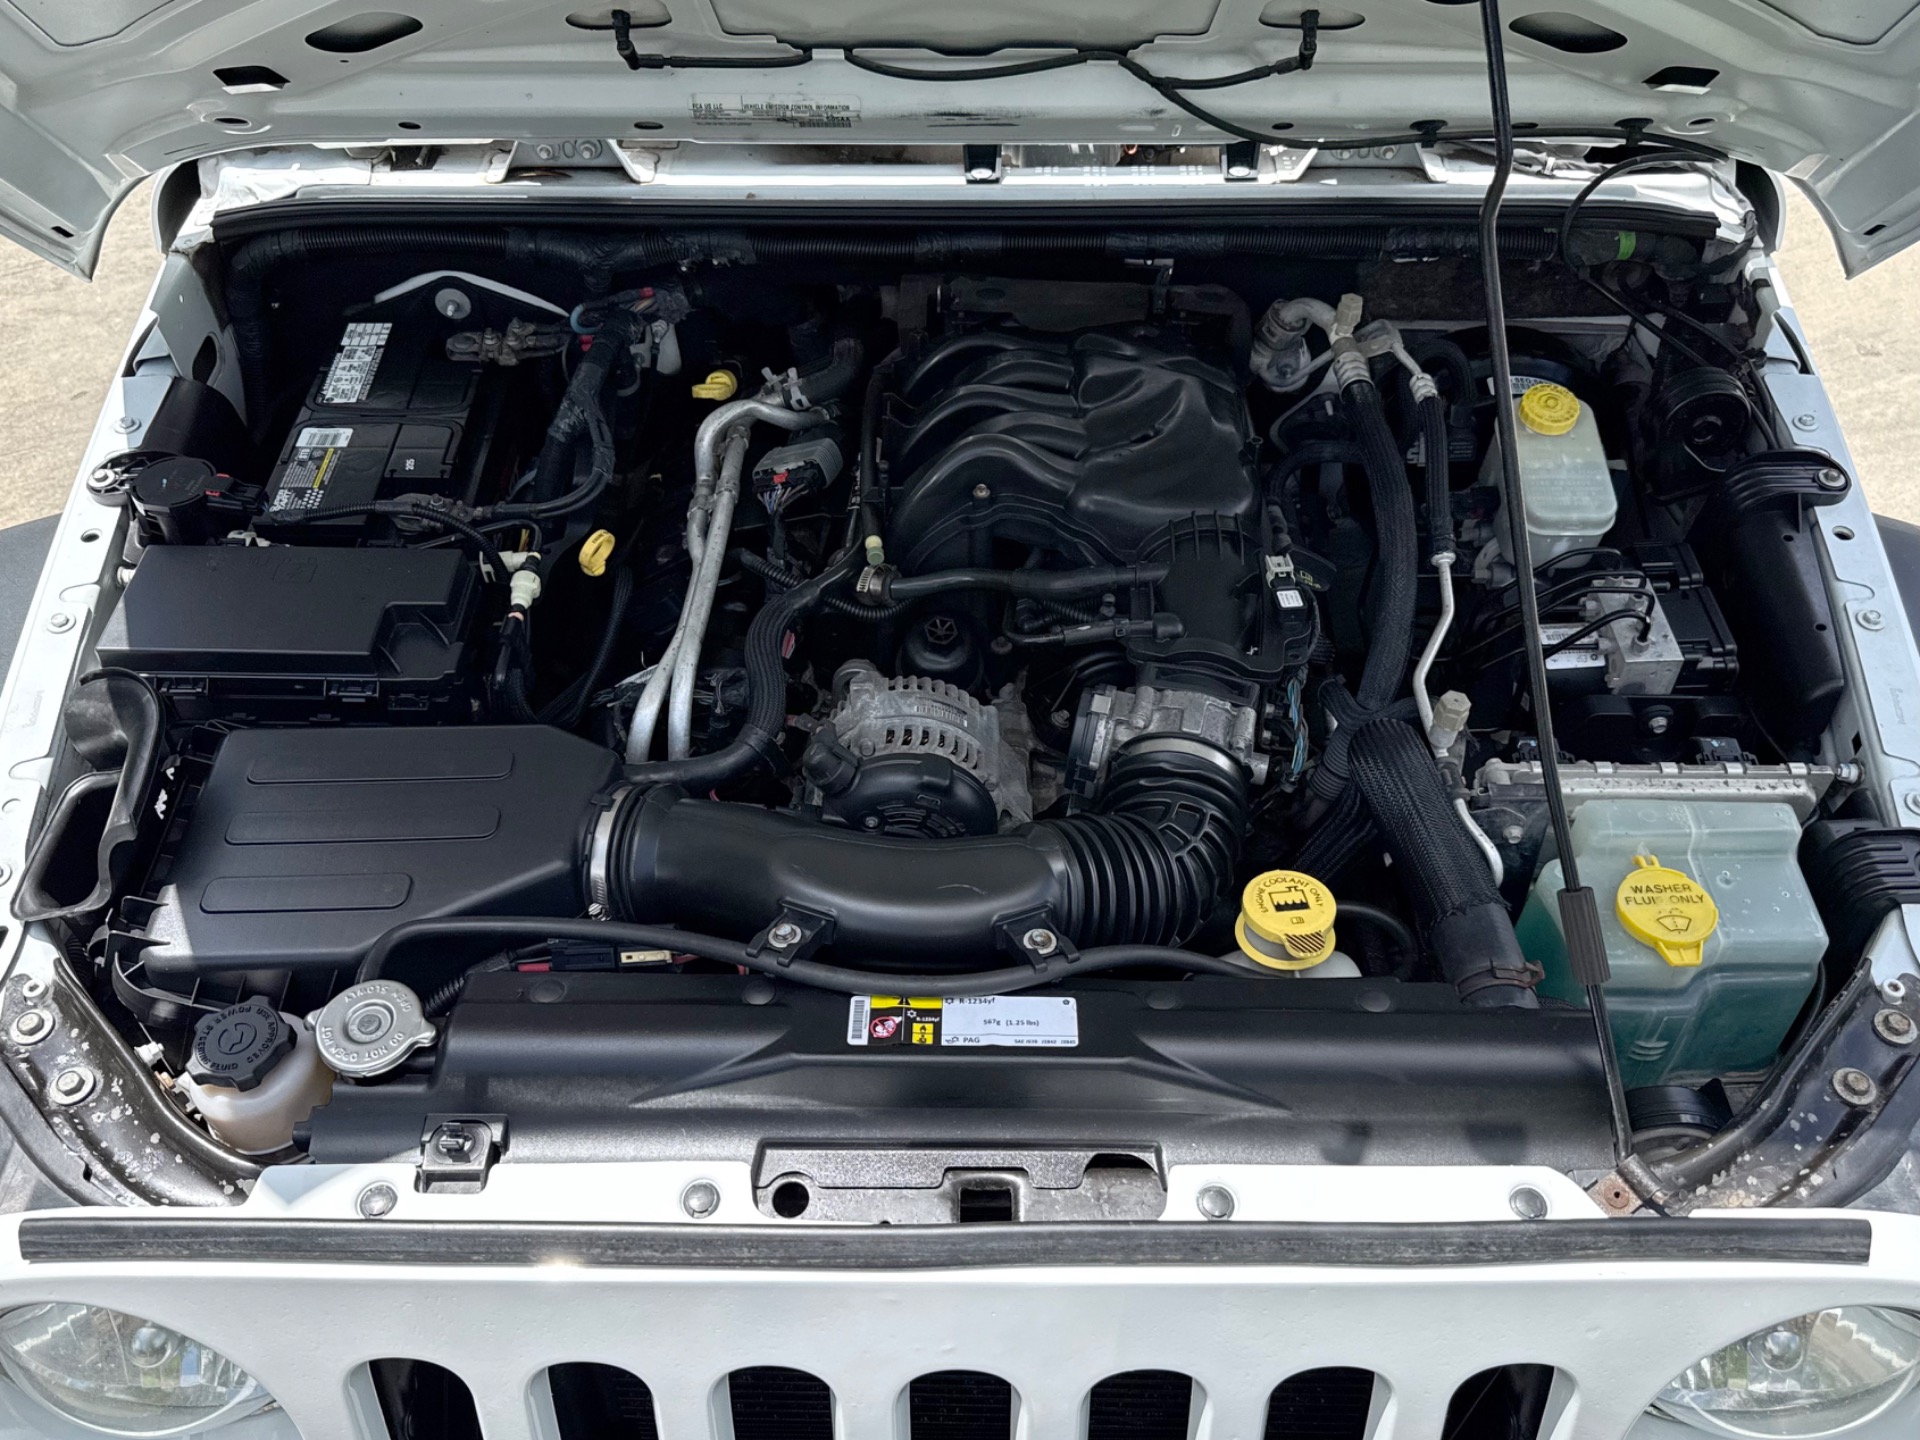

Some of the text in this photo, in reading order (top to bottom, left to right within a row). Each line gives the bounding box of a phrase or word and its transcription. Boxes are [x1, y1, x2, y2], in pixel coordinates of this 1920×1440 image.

[1256, 878, 1323, 913] ENGINE COOLANT ONLY
[1630, 883, 1692, 894] WASHER
[1669, 894, 1704, 904] ONLY
[344, 985, 412, 1012] OPEN SLOWLY
[959, 997, 995, 1005] R-1234yf
[197, 1005, 251, 1071] POWER STEERING FLUID
[246, 1007, 276, 1063] USE APPROVED
[389, 1032, 404, 1046] DO
[331, 1045, 359, 1062] OPEN
[363, 1045, 388, 1060] NOT
